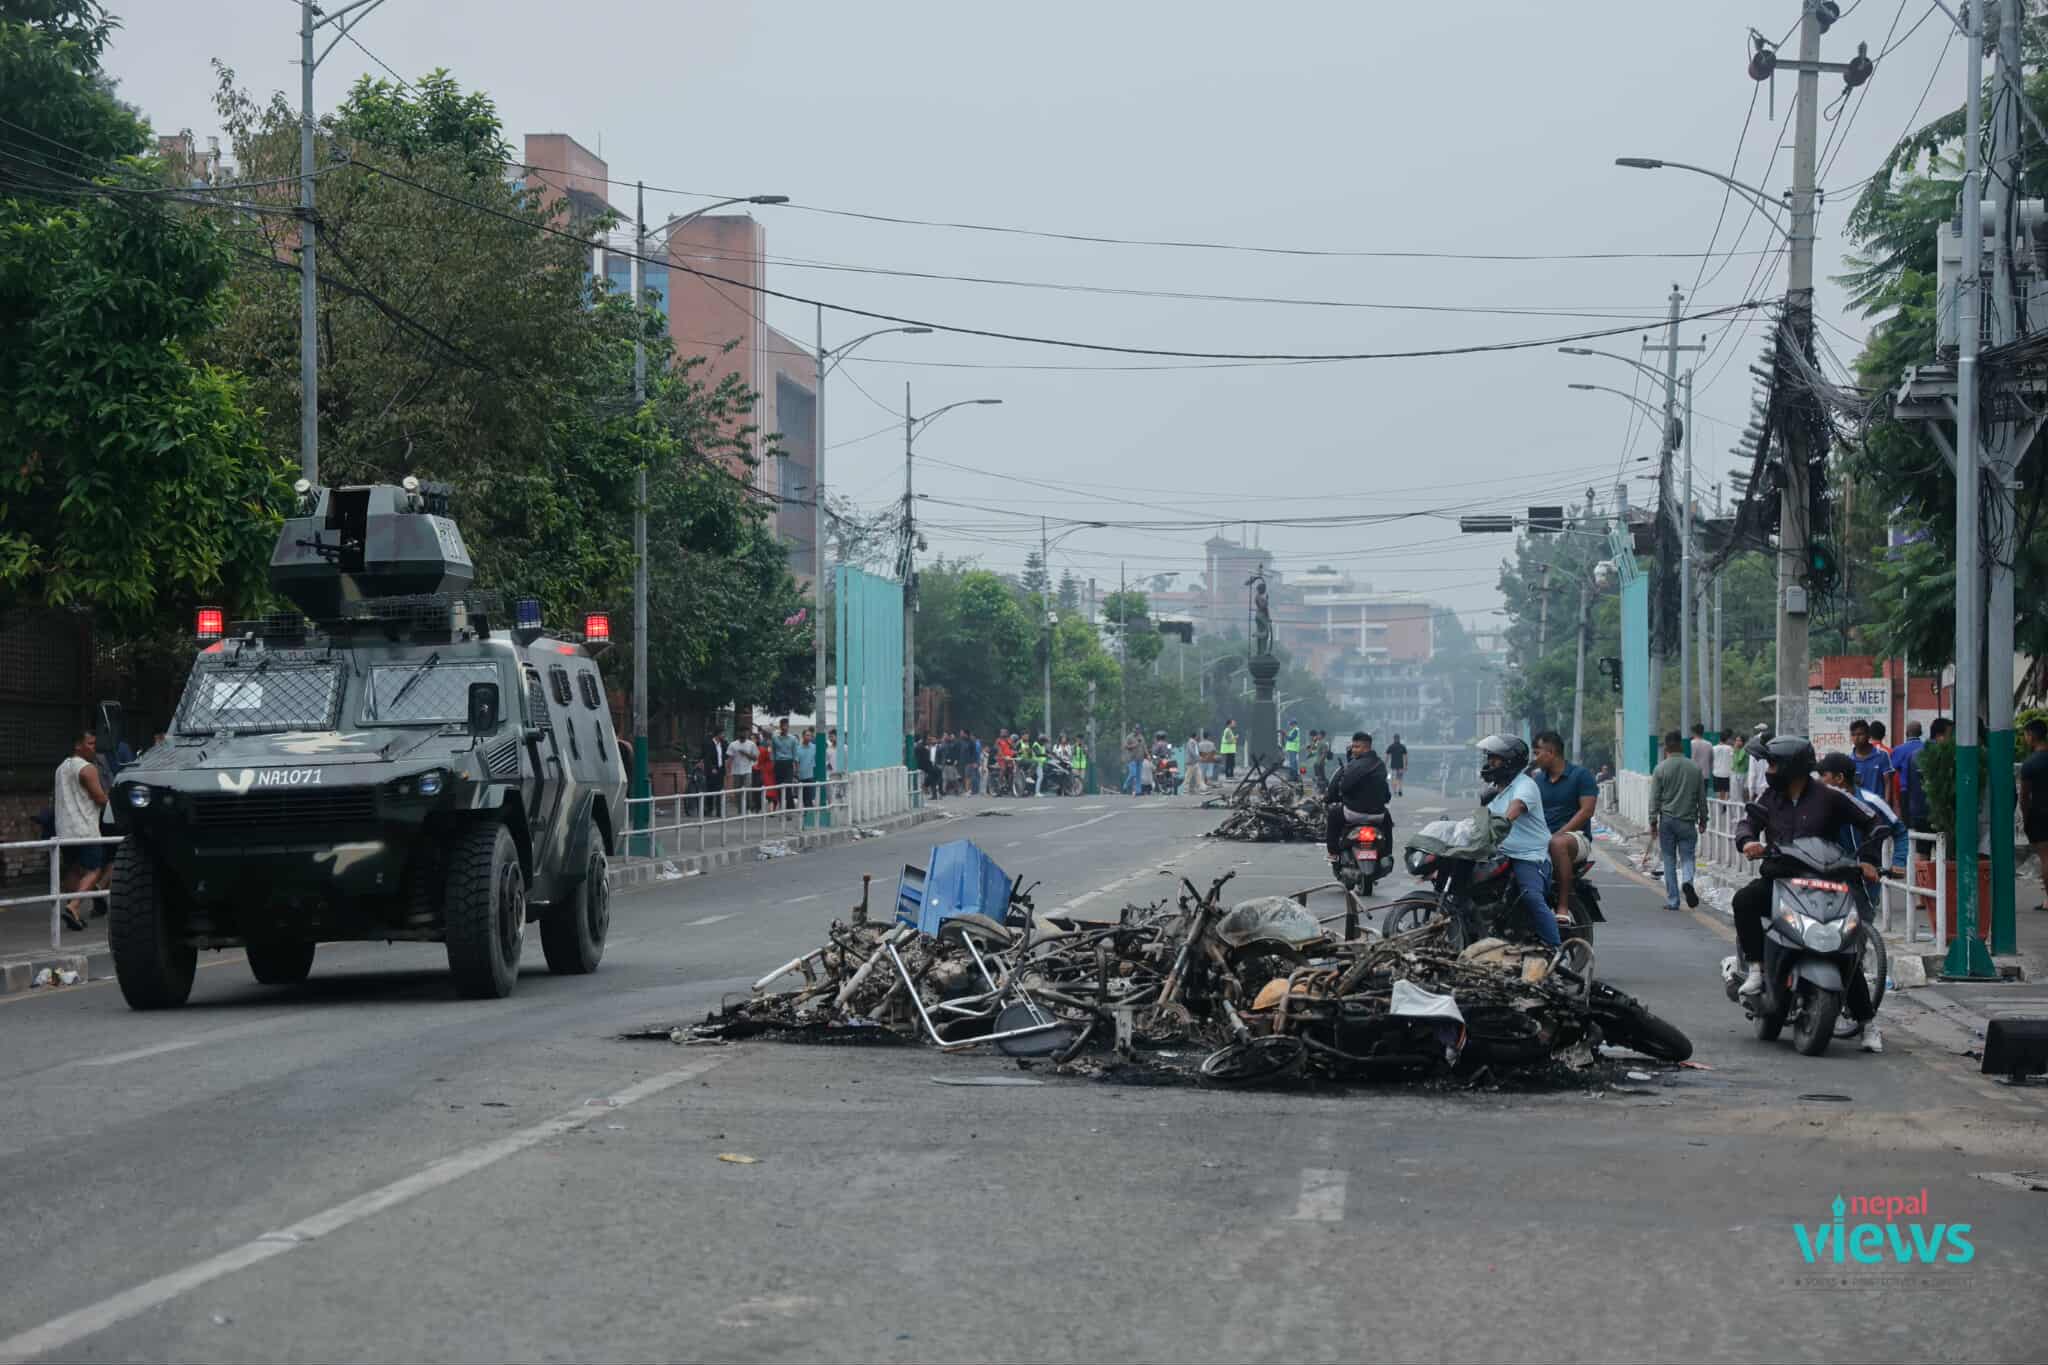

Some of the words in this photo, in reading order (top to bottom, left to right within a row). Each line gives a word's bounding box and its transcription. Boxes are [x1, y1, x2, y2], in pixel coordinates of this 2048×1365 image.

[1823, 691, 1854, 705] GLOBAL
[1859, 690, 1886, 705] MEET
[258, 768, 322, 785] NA1071
